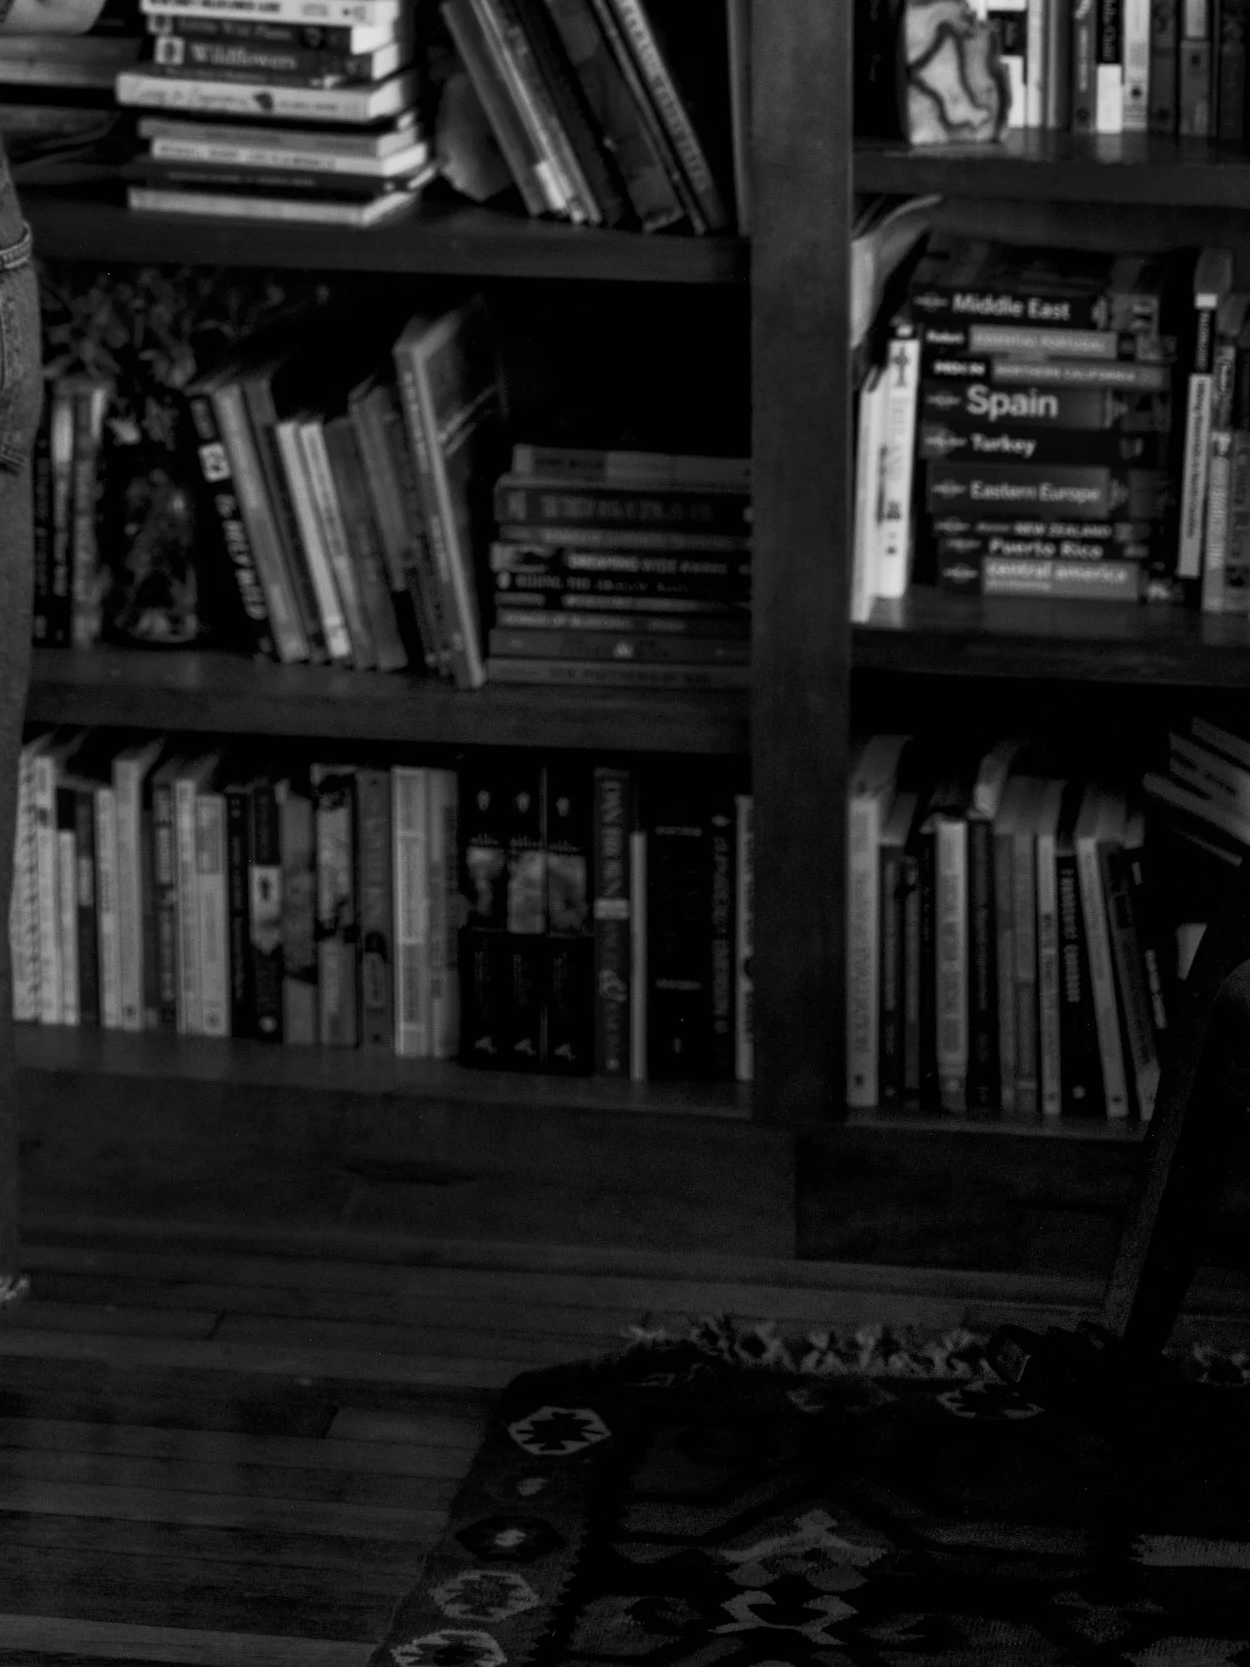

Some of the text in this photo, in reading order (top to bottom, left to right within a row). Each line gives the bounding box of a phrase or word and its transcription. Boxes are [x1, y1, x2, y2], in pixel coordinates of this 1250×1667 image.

[191, 43, 298, 70] Wildflowers
[951, 293, 1070, 320] Middle East
[966, 384, 1059, 422] Spain
[970, 433, 1037, 458] Turkey
[970, 480, 1100, 504] Eastern Europe
[989, 540, 1104, 558] Puerto Rico
